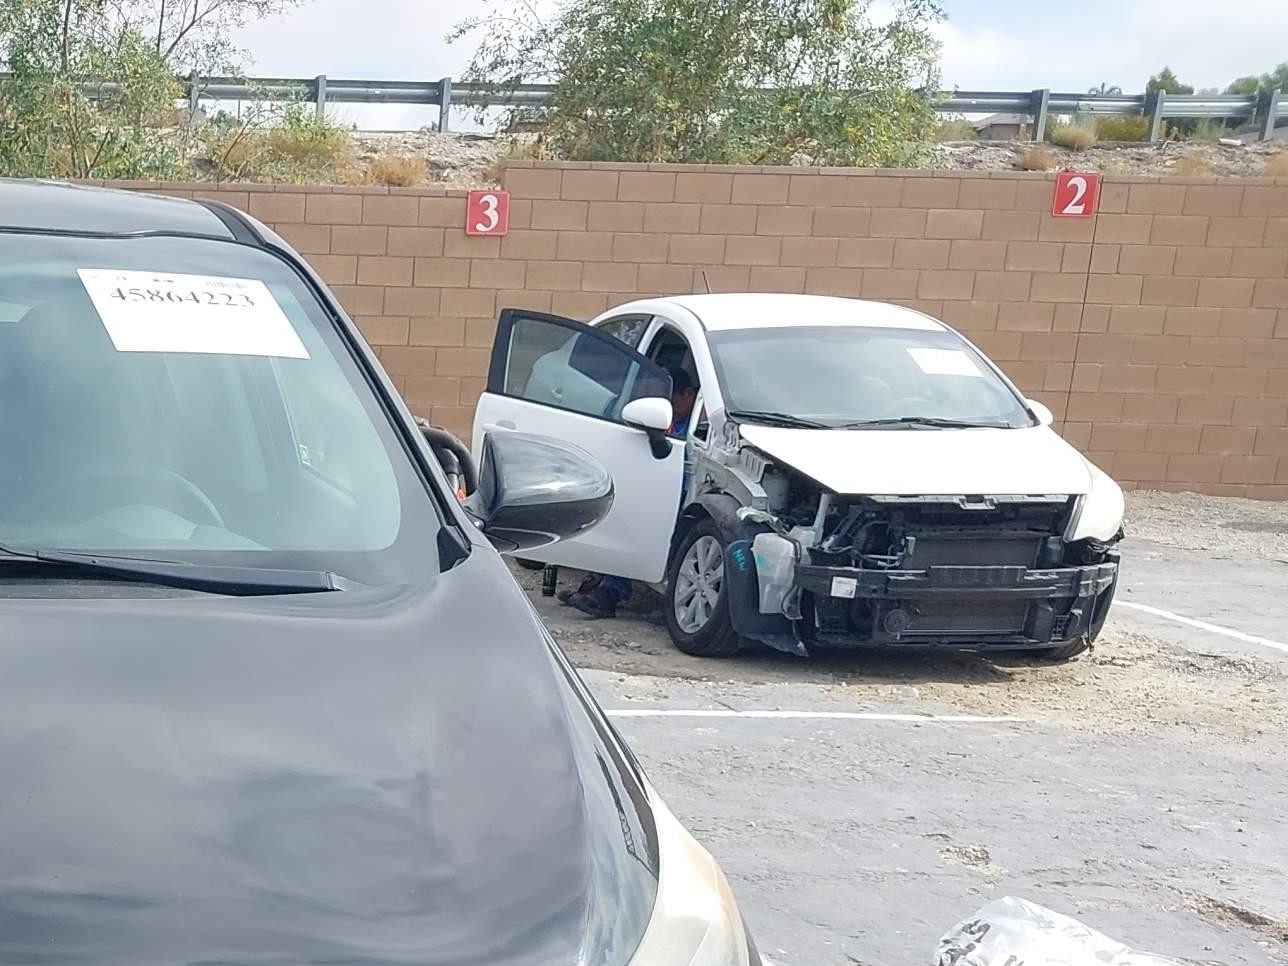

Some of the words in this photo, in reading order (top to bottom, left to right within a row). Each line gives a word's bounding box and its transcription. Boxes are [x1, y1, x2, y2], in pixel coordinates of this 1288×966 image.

[475, 194, 499, 232] 3
[1062, 176, 1087, 214] 2
[110, 287, 256, 307] 45864223
